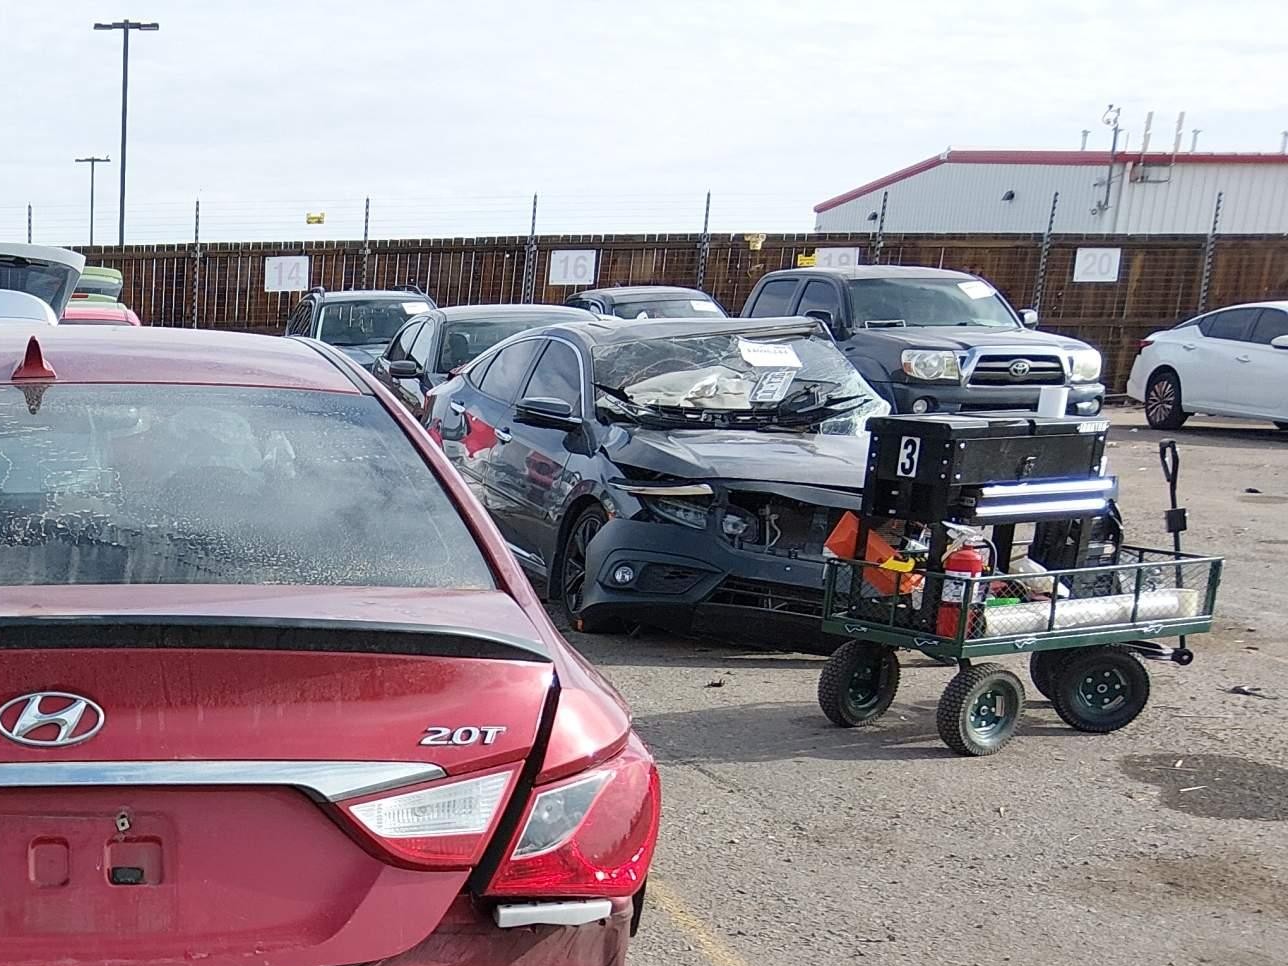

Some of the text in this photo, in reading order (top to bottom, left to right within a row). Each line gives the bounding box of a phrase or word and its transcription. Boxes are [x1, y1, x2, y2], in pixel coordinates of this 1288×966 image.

[273, 262, 302, 286] 14
[559, 255, 588, 279] 16
[1082, 252, 1113, 276] 20
[901, 438, 917, 476] 3
[419, 726, 508, 746] 2.0T
